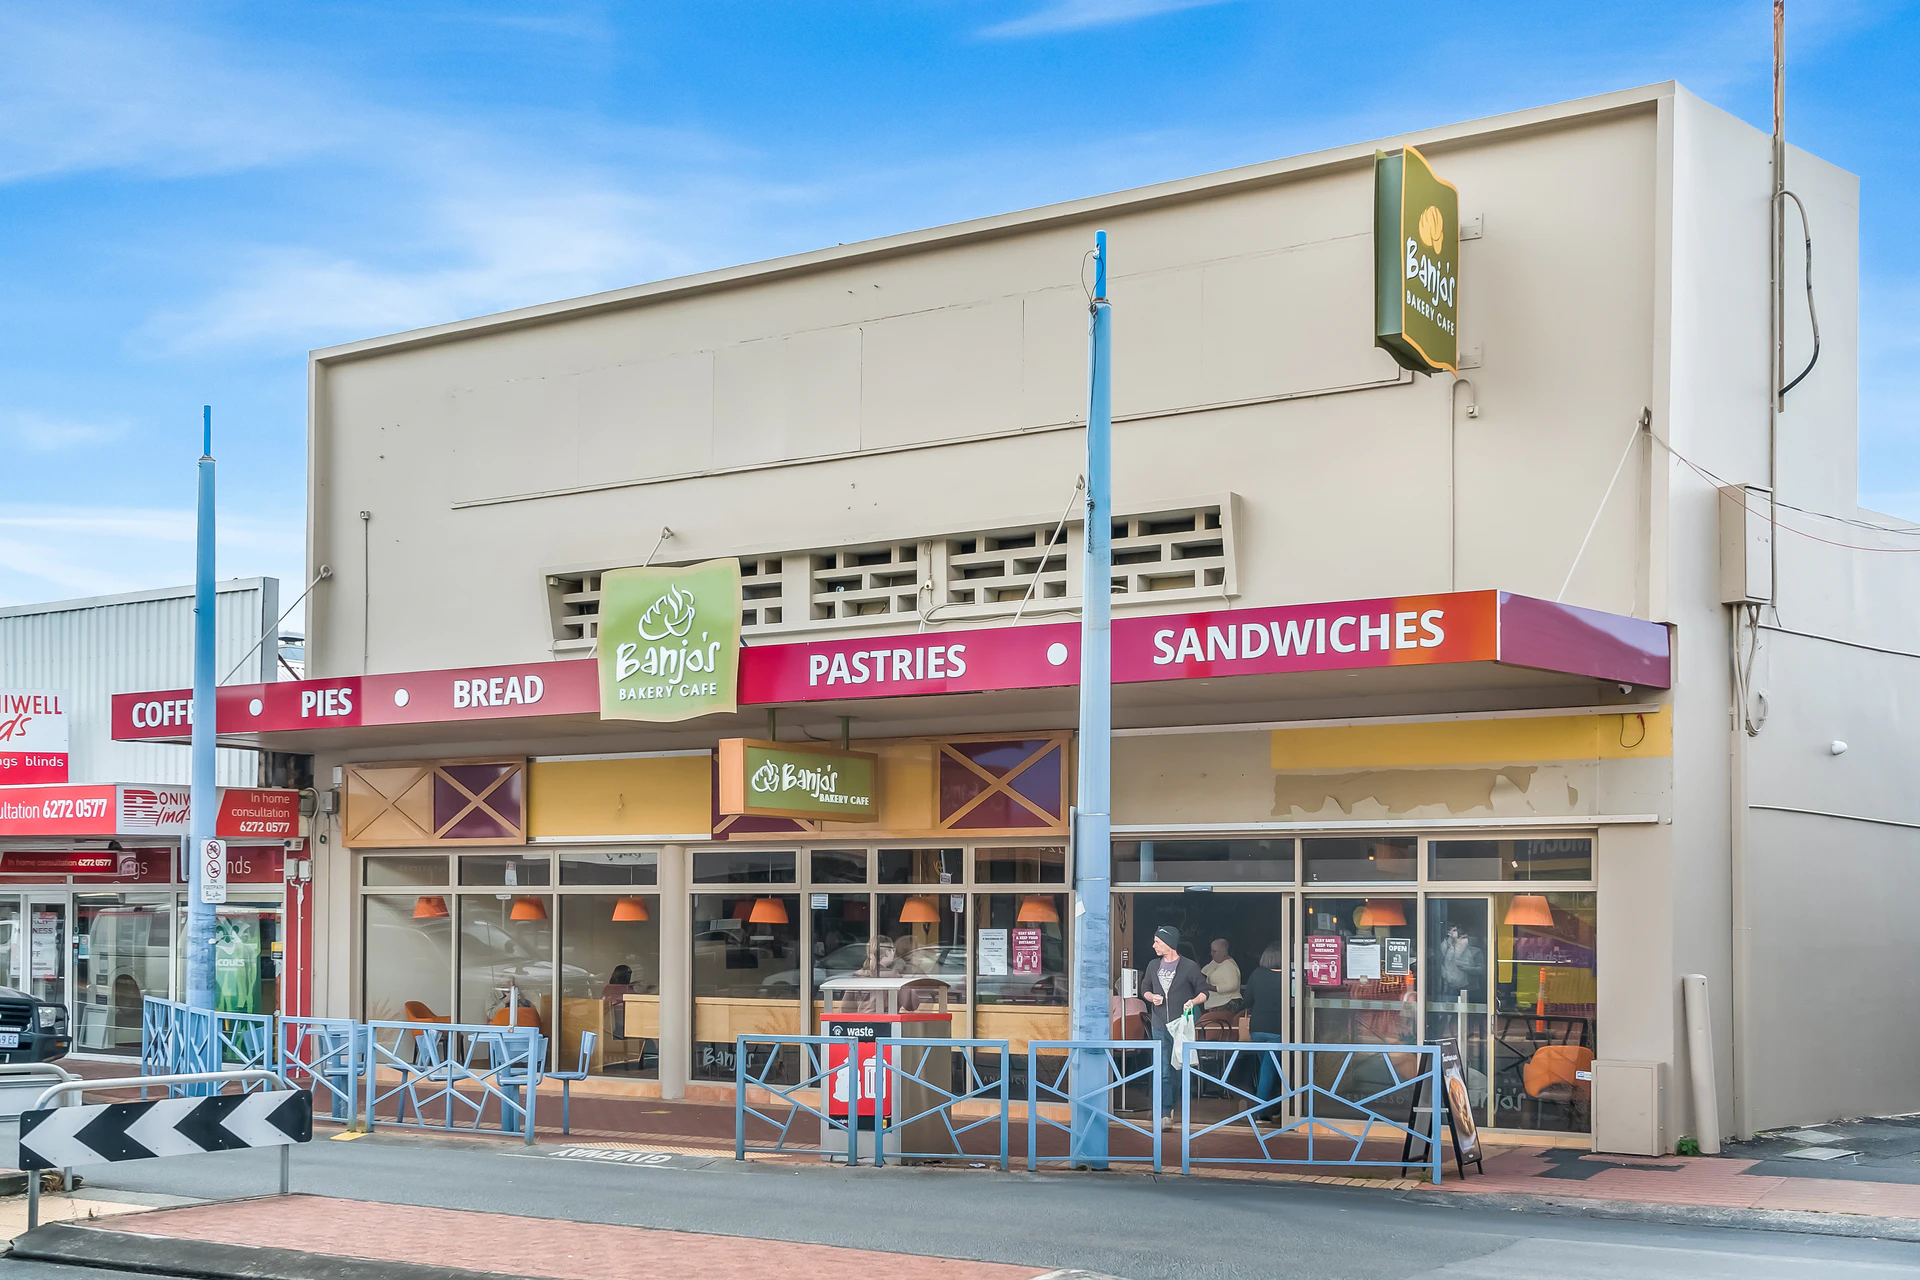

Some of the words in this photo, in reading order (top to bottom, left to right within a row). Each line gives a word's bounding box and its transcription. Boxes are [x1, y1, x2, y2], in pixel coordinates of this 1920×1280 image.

[1406, 236, 1455, 308] Banjo's
[1406, 289, 1435, 321] BAKERY
[1436, 312, 1455, 336] CAFE
[1152, 608, 1446, 666] SANDWICHES
[615, 631, 721, 685] Banjo's
[808, 643, 968, 687] PASTRIES
[452, 674, 545, 709] BREAD
[619, 685, 674, 701] BAKERY
[679, 682, 717, 697] CAFE
[0, 694, 62, 715] IWELL
[301, 687, 353, 719] PIES
[132, 699, 194, 729] COFFE
[25, 755, 64, 767] blinds
[782, 762, 838, 798] Banjo's
[42, 799, 74, 819] 6272
[75, 798, 108, 818] 0577
[251, 792, 260, 803] In
[262, 792, 290, 804] home
[819, 793, 848, 804] BAKERY
[850, 795, 869, 806] CAFE
[231, 807, 290, 818] consultation
[239, 821, 264, 833] 6272
[265, 821, 290, 833] 0577
[16, 859, 36, 867] home
[37, 858, 77, 867] consultation
[78, 859, 95, 867] 6272
[95, 859, 112, 867] 0577
[216, 957, 245, 967] couts
[847, 1026, 873, 1037] waste
